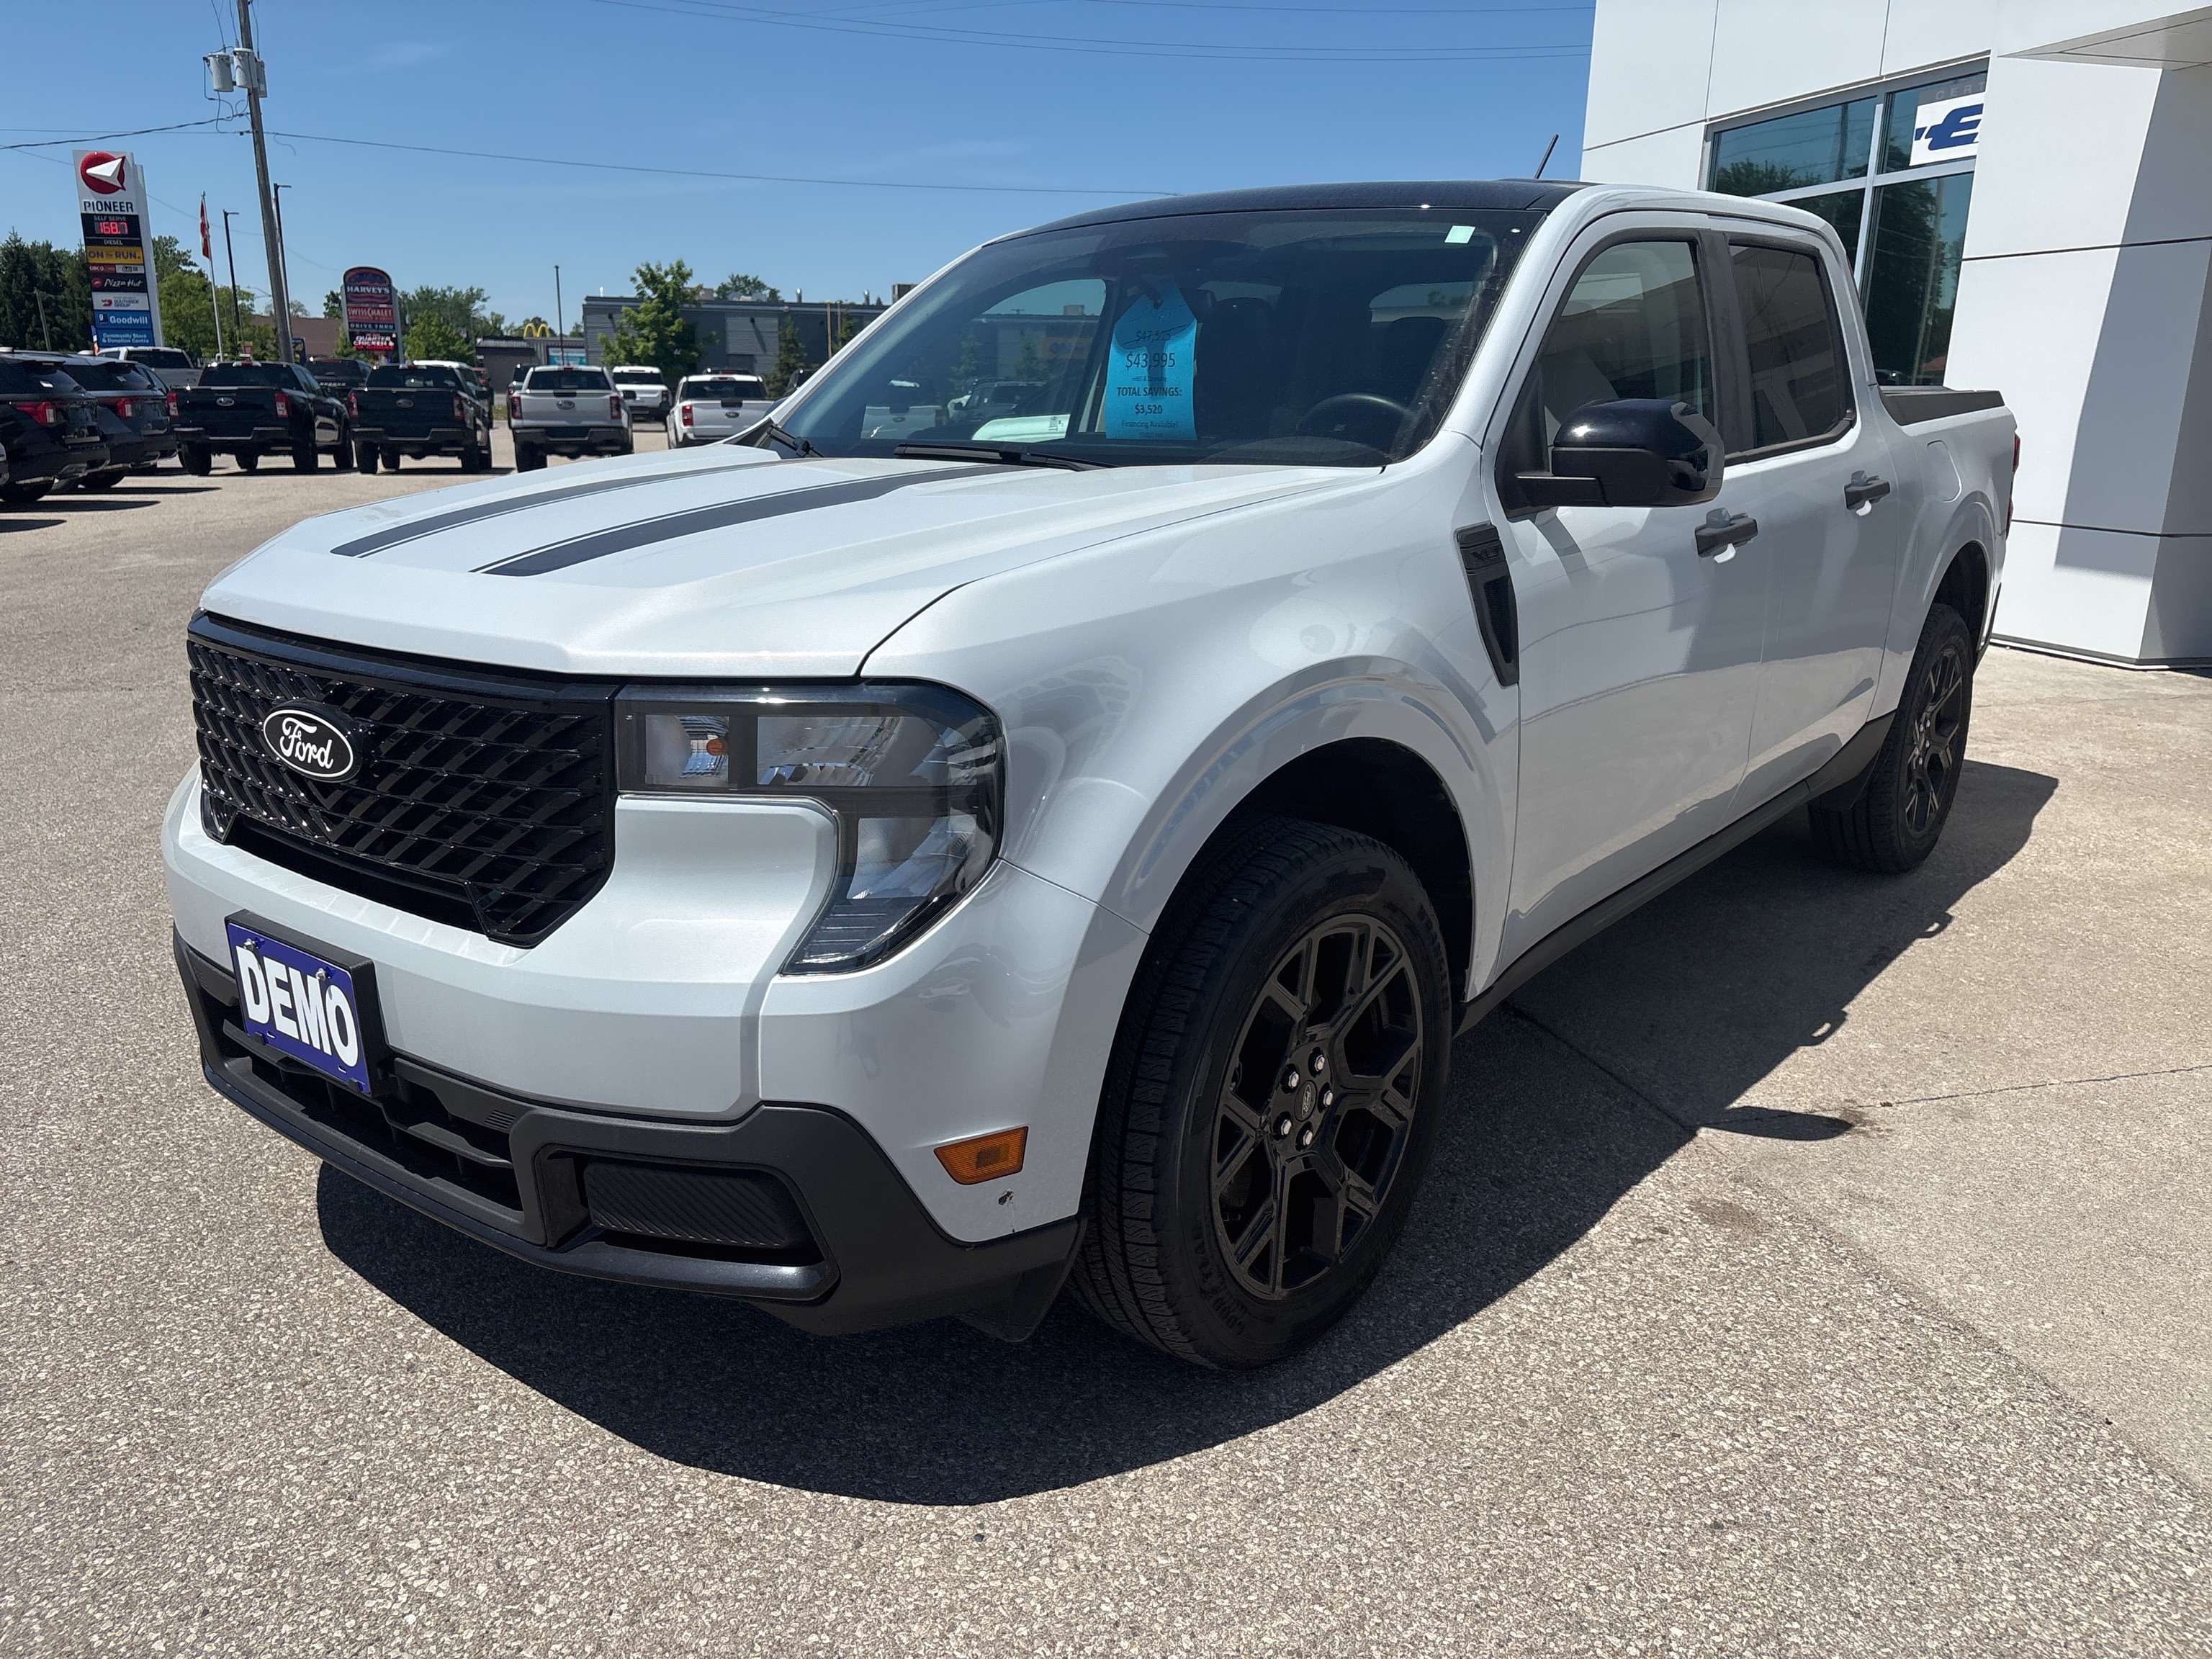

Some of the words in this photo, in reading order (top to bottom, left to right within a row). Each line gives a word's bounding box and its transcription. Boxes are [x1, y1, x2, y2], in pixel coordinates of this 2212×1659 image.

[84, 201, 134, 212] PIONEER
[104, 278, 126, 288] Pizza
[127, 279, 143, 287] Hut
[346, 286, 390, 295] HARVEY'S
[109, 315, 148, 324] Goodwill
[1125, 351, 1176, 370] $43,995
[1117, 387, 1141, 397] TOTAL
[1143, 387, 1182, 397] SAVINGS:
[1135, 404, 1163, 415] $3,520
[279, 717, 334, 769] Ford
[235, 945, 359, 1067] DEMO
